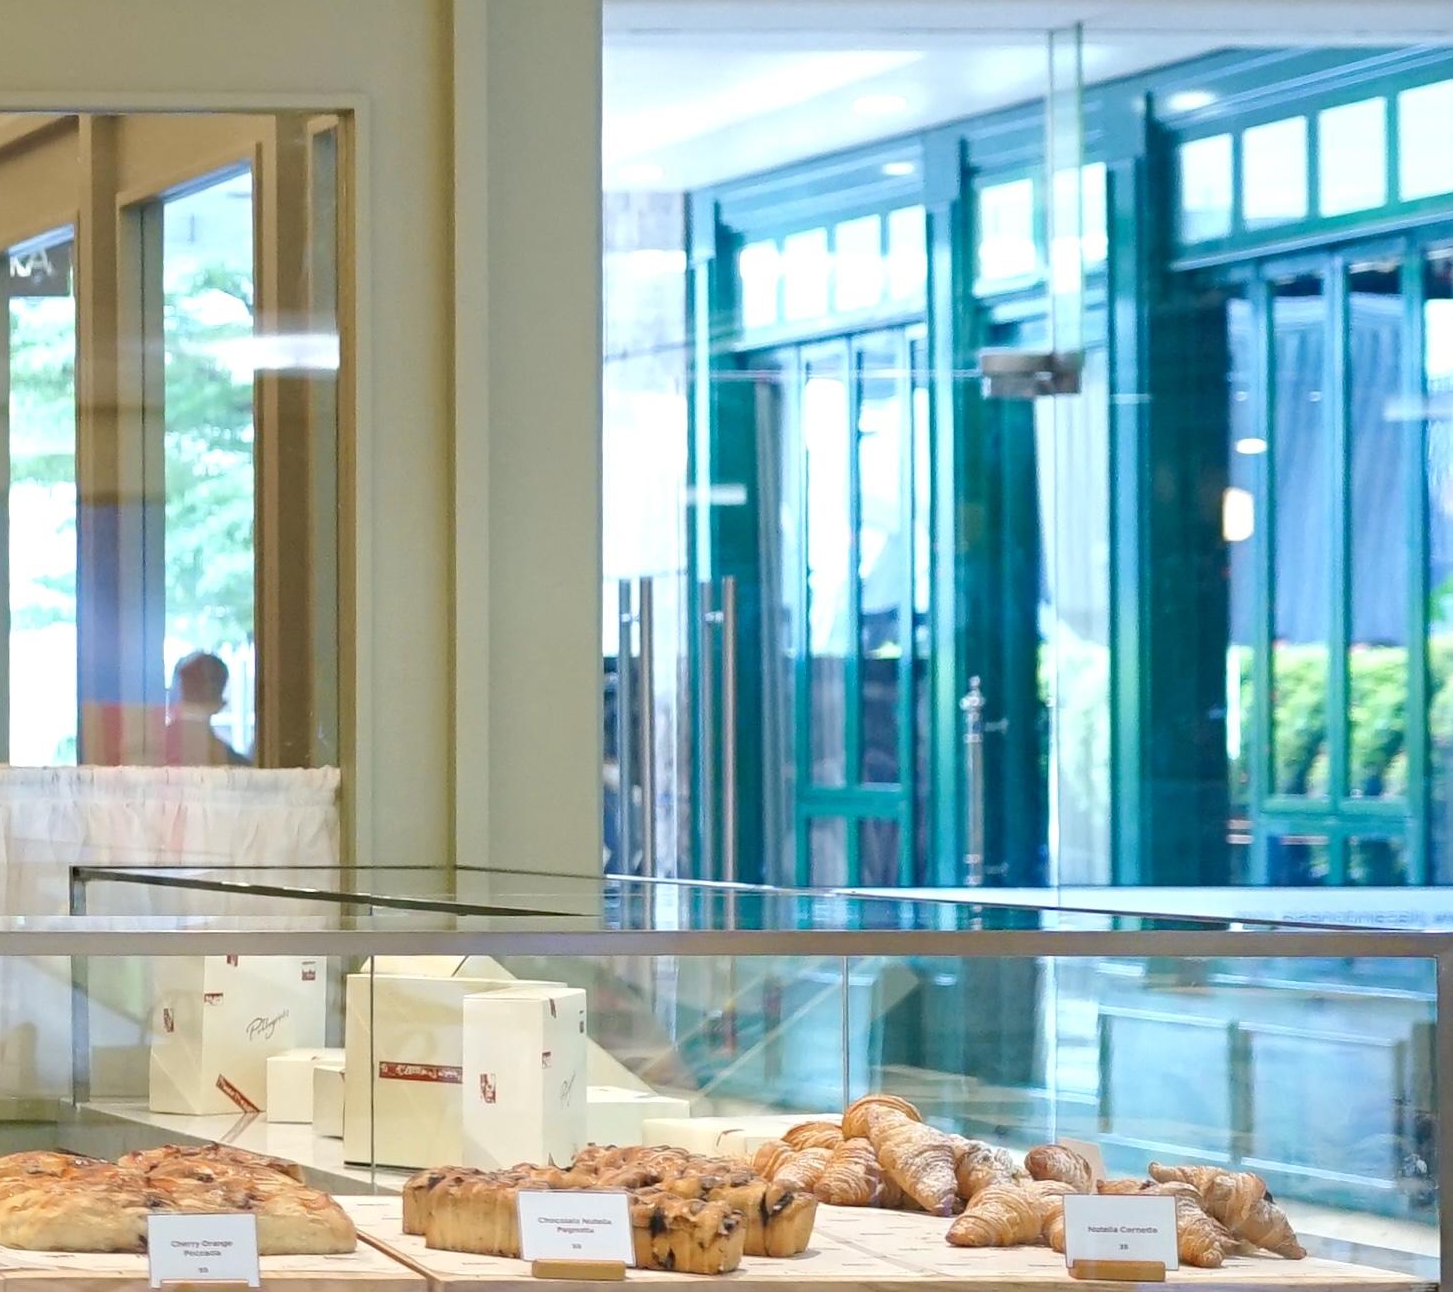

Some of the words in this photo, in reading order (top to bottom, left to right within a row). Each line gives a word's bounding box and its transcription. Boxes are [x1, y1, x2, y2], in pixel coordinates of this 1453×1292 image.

[581, 1217, 613, 1225] Nutella
[1087, 1226, 1119, 1234] Nutella
[170, 1240, 200, 1249] Cherry
[201, 1239, 234, 1248] Orange
